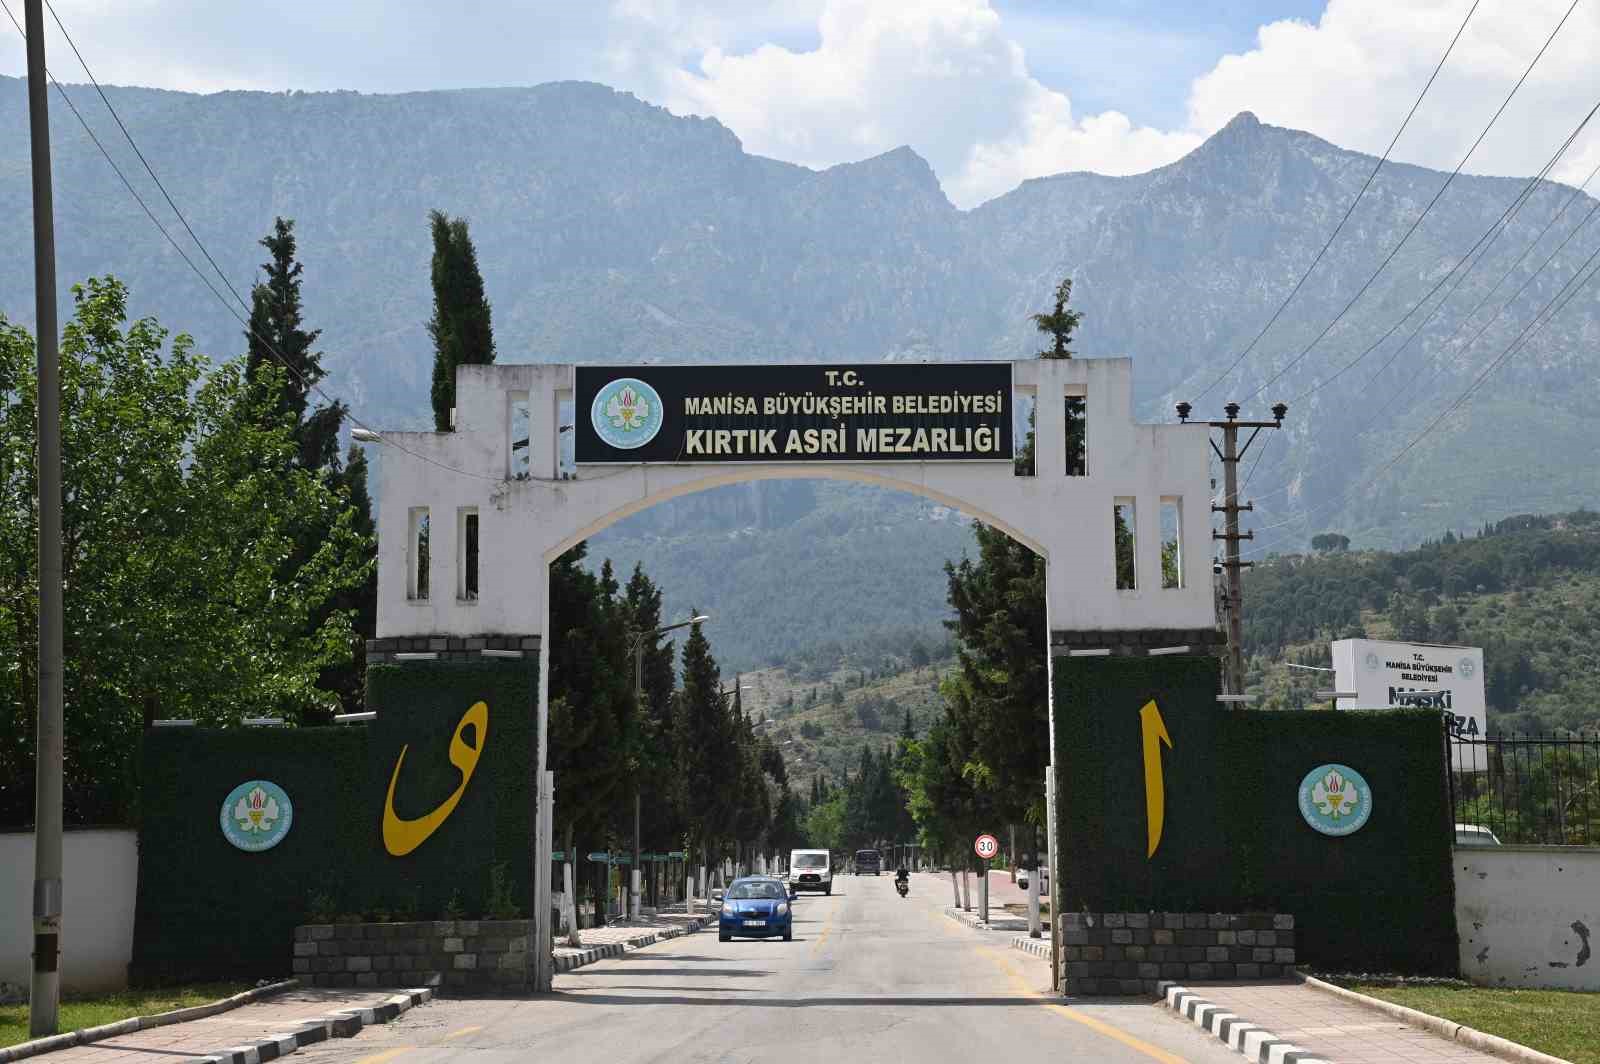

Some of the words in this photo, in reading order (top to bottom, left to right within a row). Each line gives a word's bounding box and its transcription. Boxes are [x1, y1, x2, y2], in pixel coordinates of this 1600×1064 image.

[825, 371, 864, 387] T.C.
[685, 392, 758, 415] MANİSA
[763, 391, 887, 419] BÜYÜKŞEHİR
[892, 390, 1002, 414] BELEDİYESİ
[686, 429, 777, 454] KIRTIK
[784, 422, 846, 454] ASRİ
[856, 423, 1000, 453] MEZARLIĞI
[1412, 653, 1425, 662] T.C.
[1385, 661, 1411, 671] MANİSA
[1401, 673, 1438, 682] BELEDİYESİ
[979, 841, 993, 852] 30
